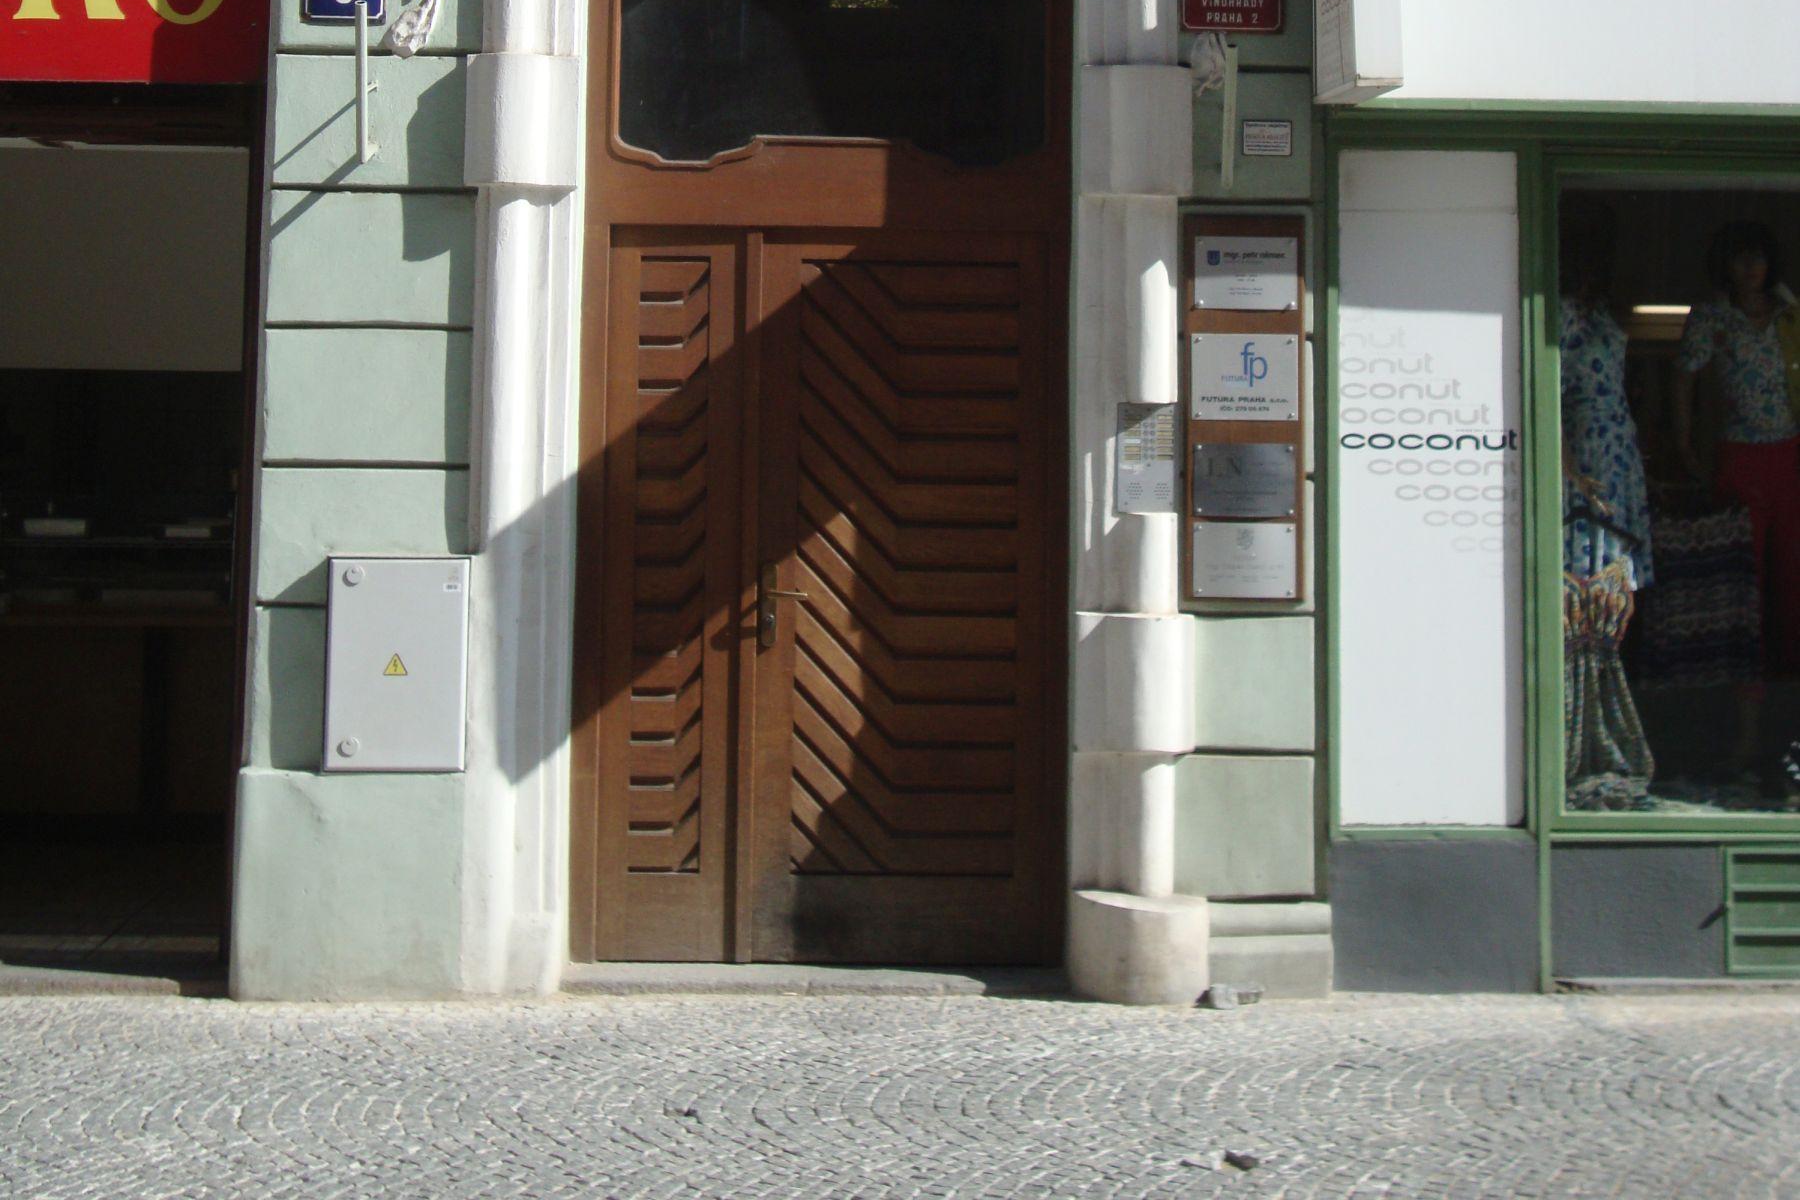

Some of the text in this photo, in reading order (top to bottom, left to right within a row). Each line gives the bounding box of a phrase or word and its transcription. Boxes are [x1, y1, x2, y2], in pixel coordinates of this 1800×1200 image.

[1206, 12, 1259, 24] PRAHA 2
[1341, 379, 1461, 400] conut
[1341, 404, 1490, 425] oconut
[1341, 429, 1517, 450] coconut
